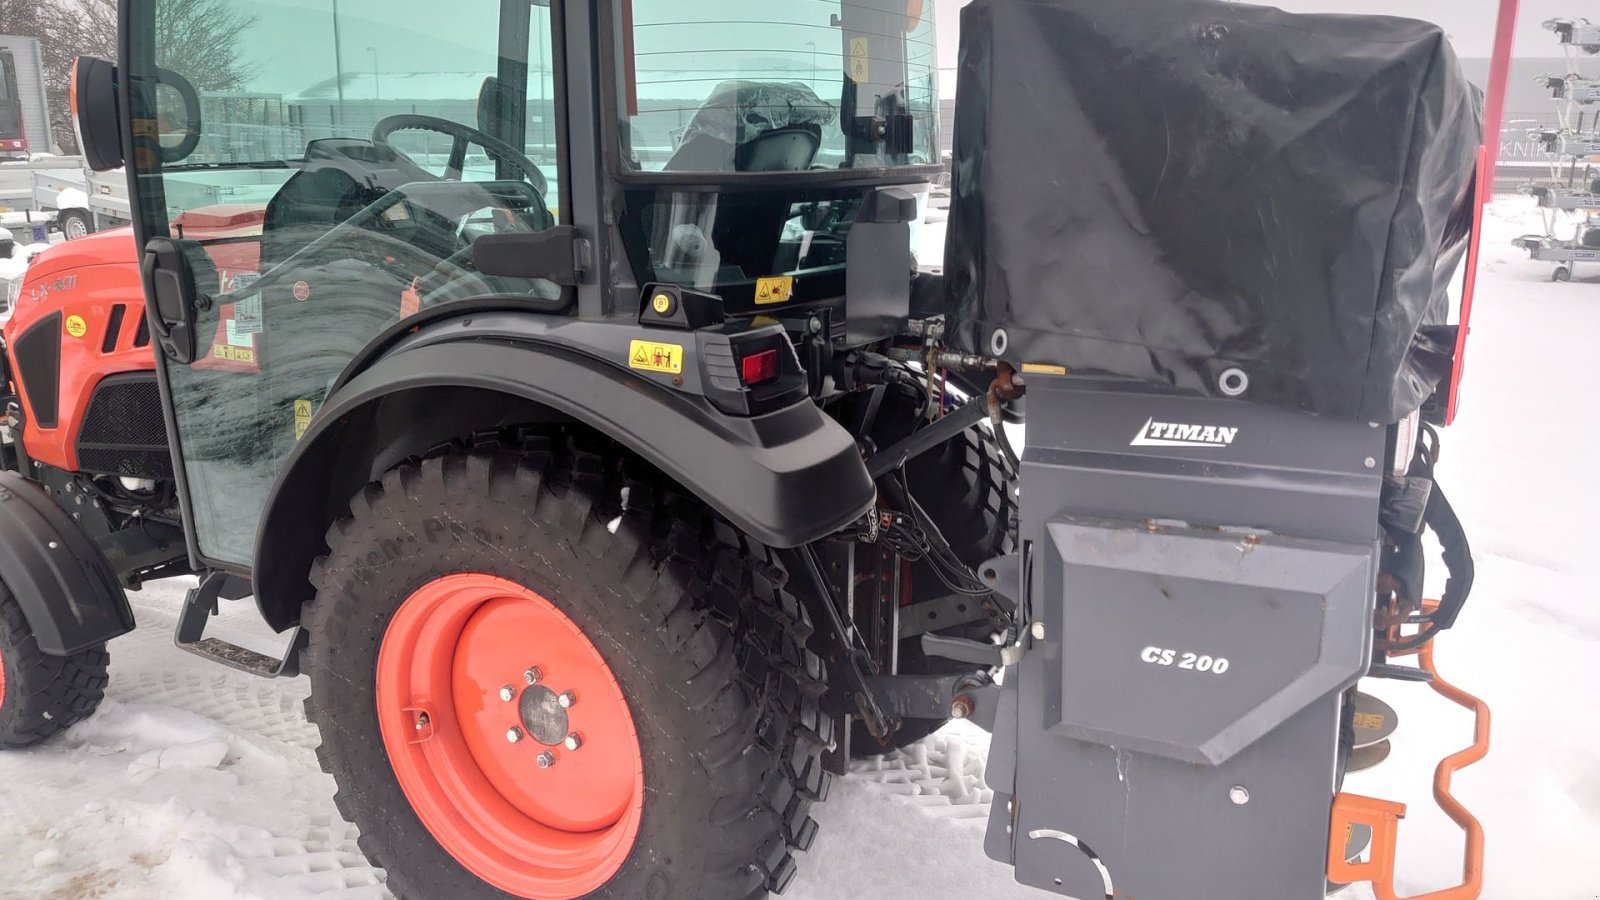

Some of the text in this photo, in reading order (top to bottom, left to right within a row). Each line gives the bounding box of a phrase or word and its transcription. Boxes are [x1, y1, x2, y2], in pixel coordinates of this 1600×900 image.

[1149, 421, 1239, 444] TIMAN
[1140, 646, 1230, 674] CS 200
